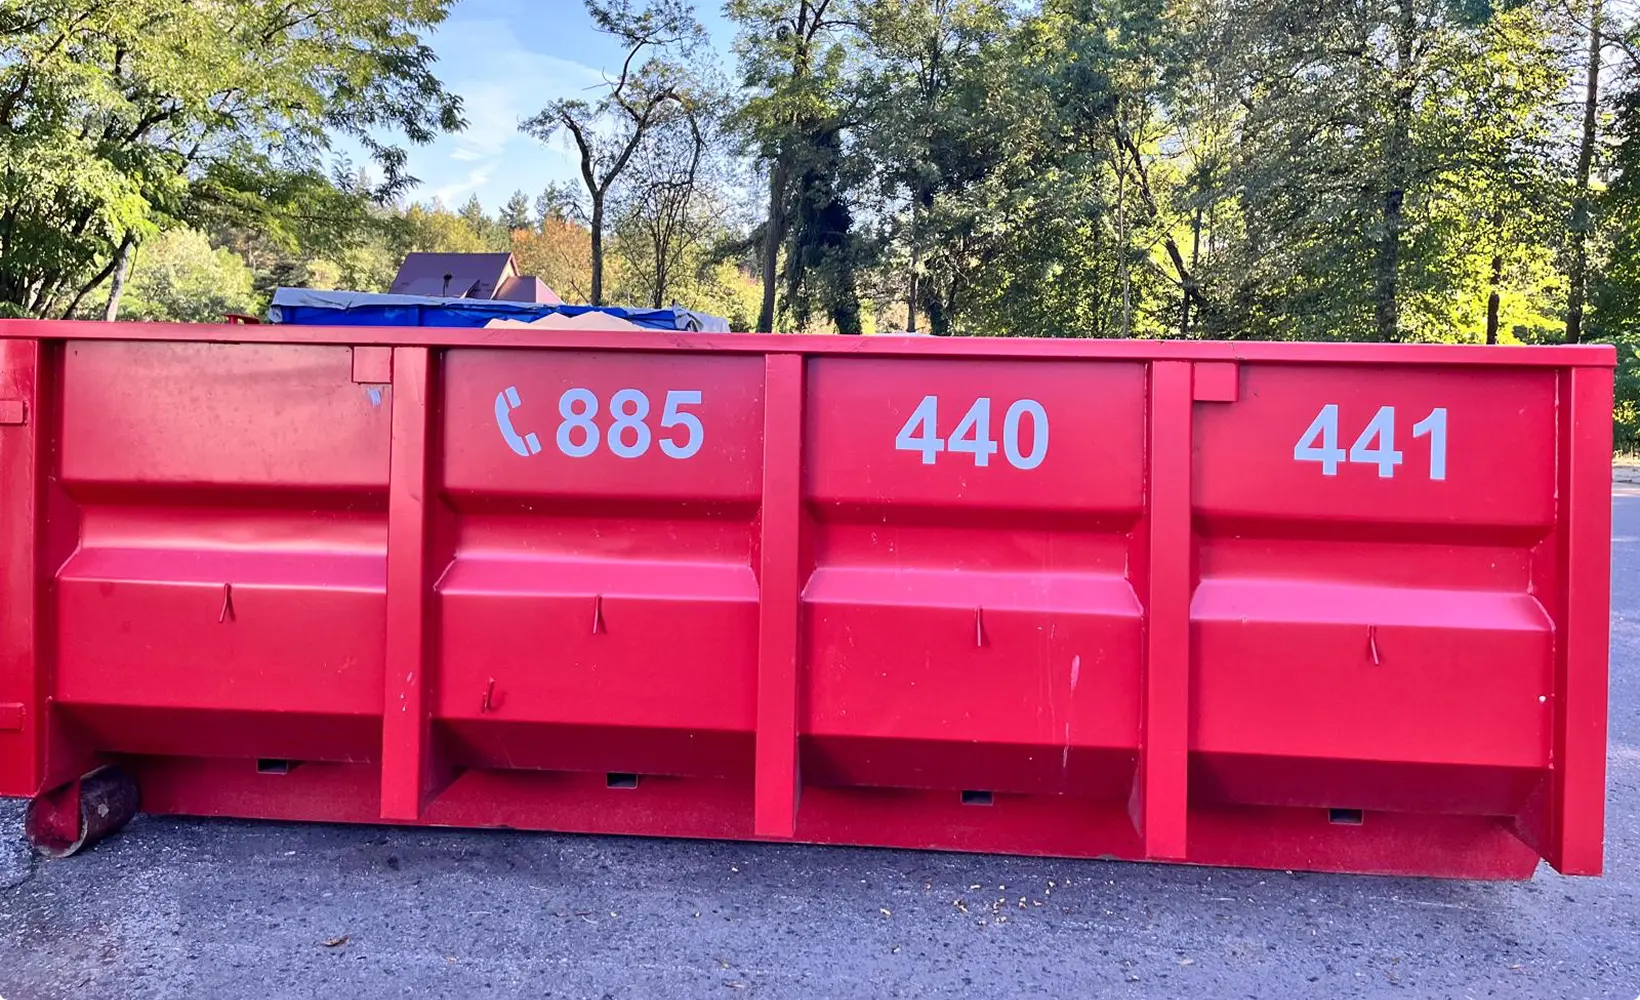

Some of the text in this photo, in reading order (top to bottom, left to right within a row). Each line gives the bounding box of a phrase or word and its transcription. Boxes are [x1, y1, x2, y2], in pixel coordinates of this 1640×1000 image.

[556, 388, 1448, 481] 885 440 441
